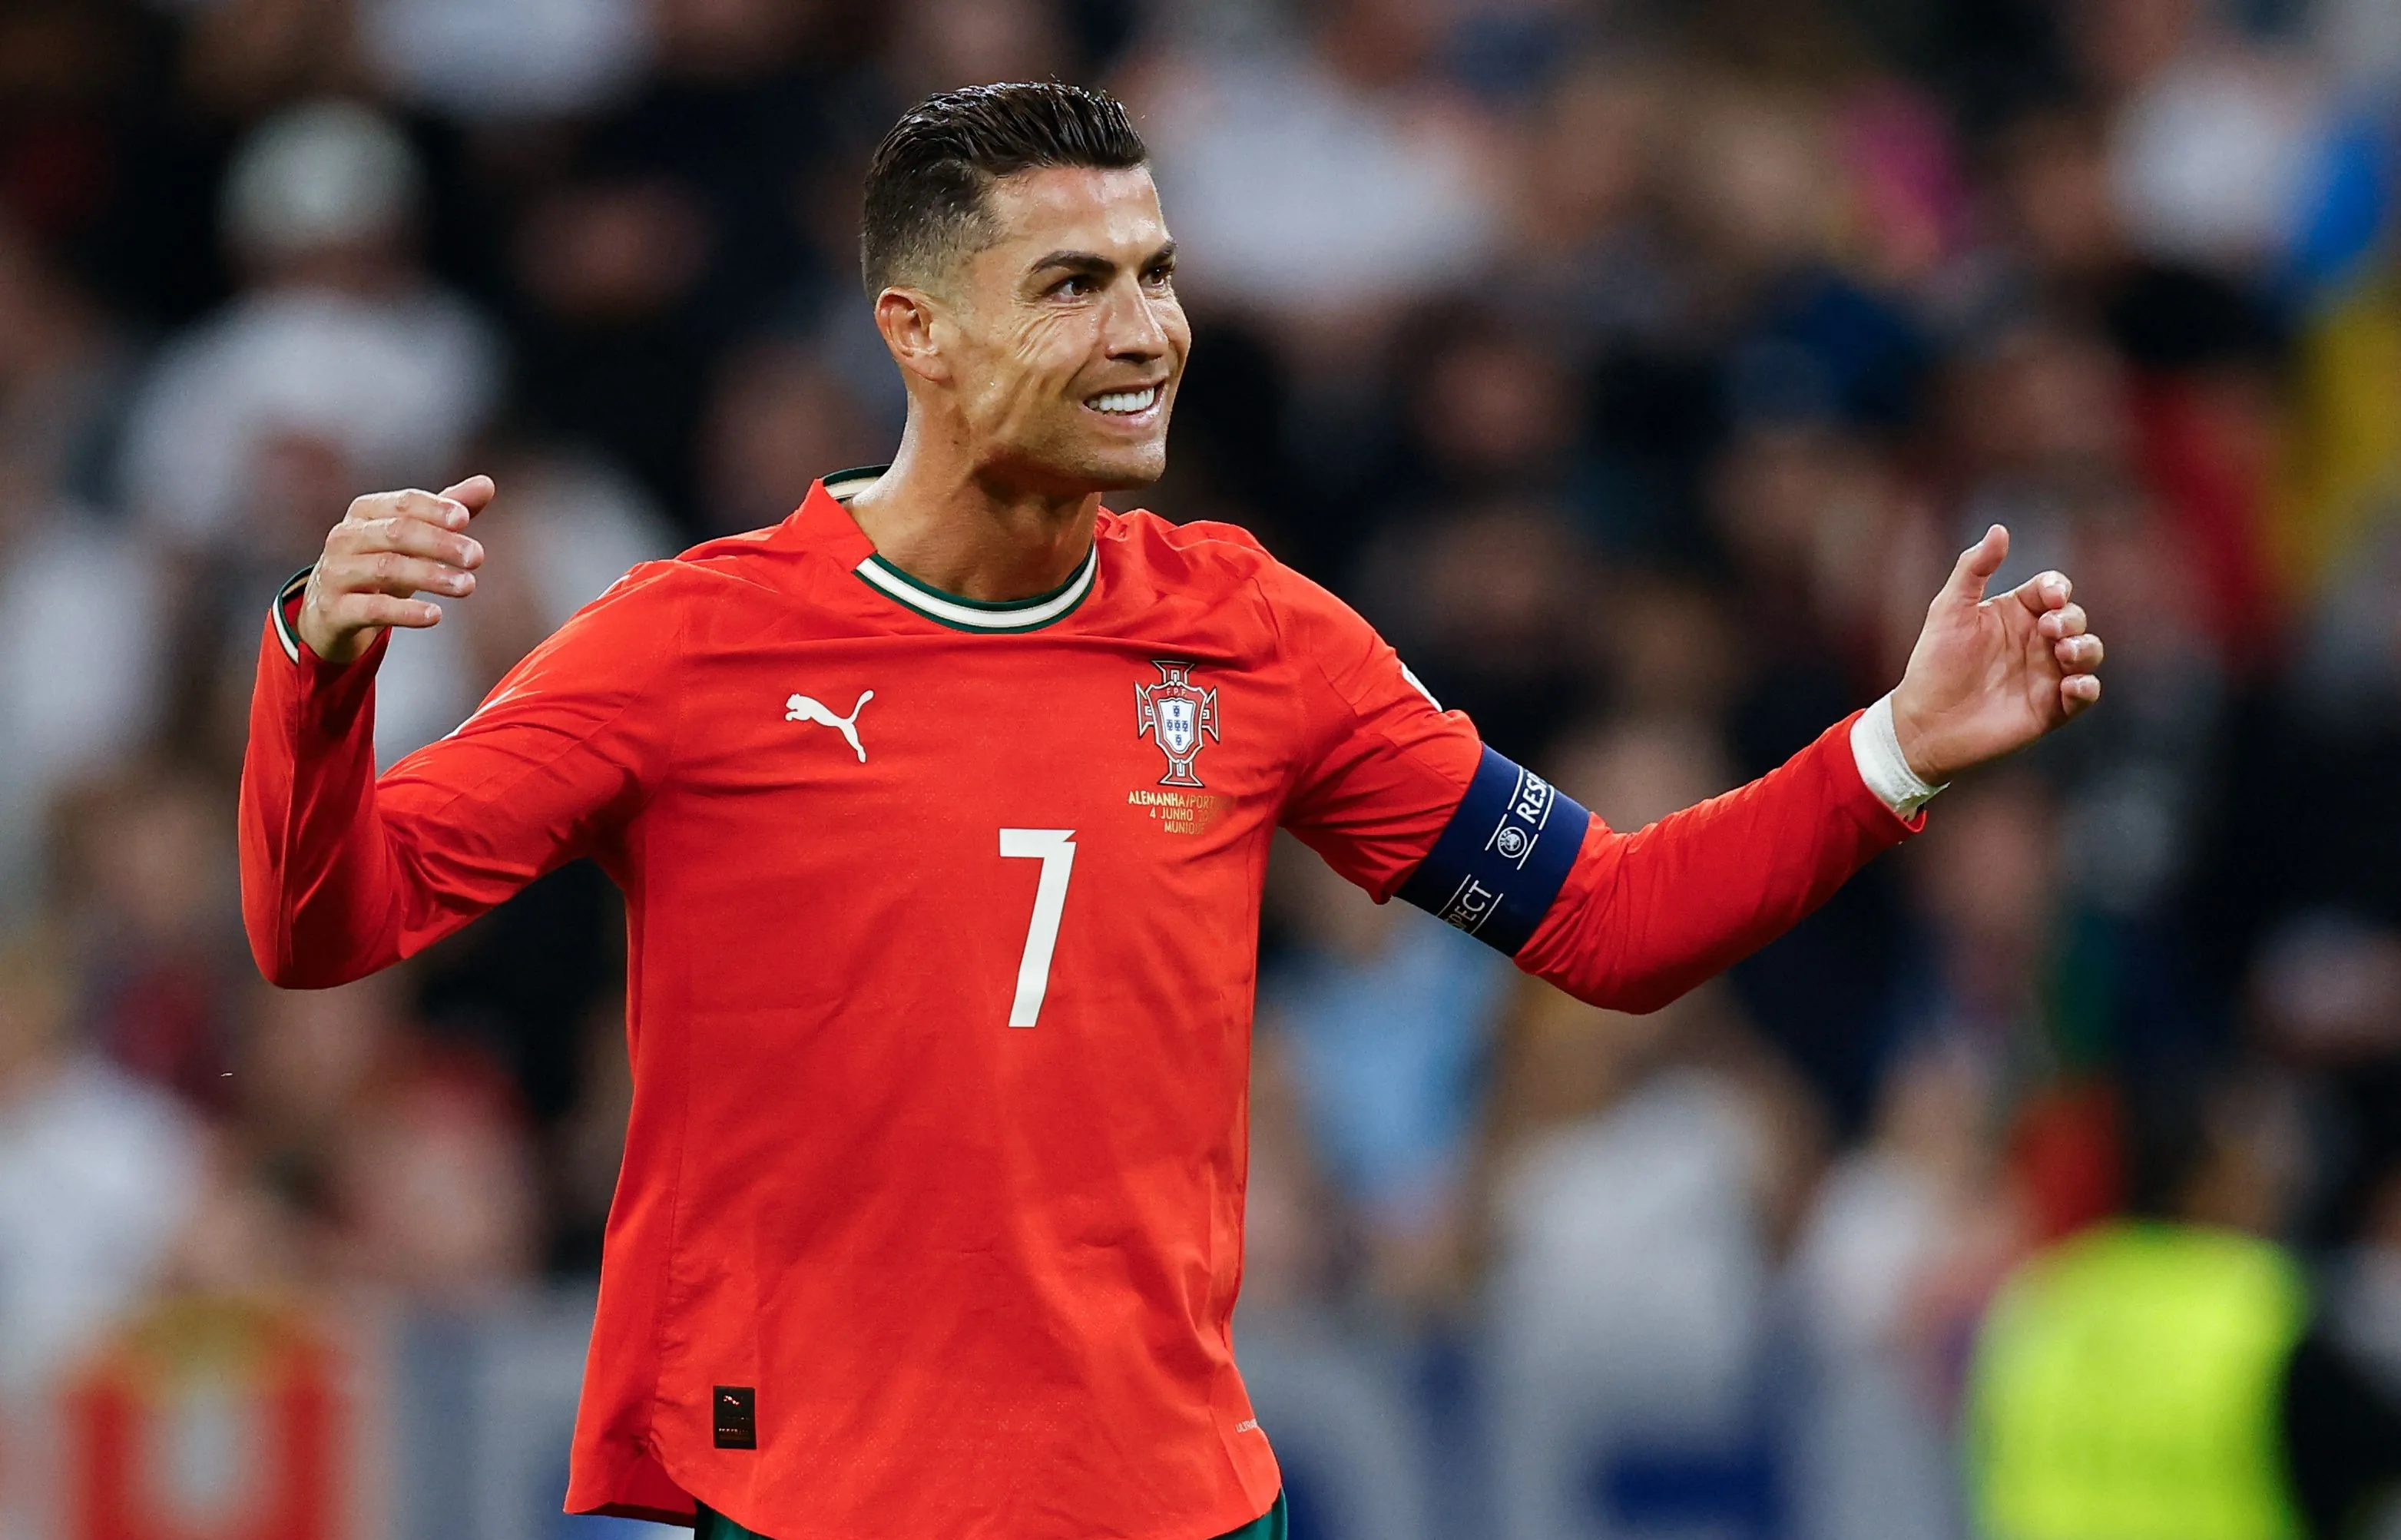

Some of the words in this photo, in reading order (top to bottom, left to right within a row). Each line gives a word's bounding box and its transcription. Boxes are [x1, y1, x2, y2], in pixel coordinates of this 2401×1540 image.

[1149, 806, 1157, 819] 4
[1161, 807, 1194, 821] JUNHO
[999, 827, 1077, 1028] 7
